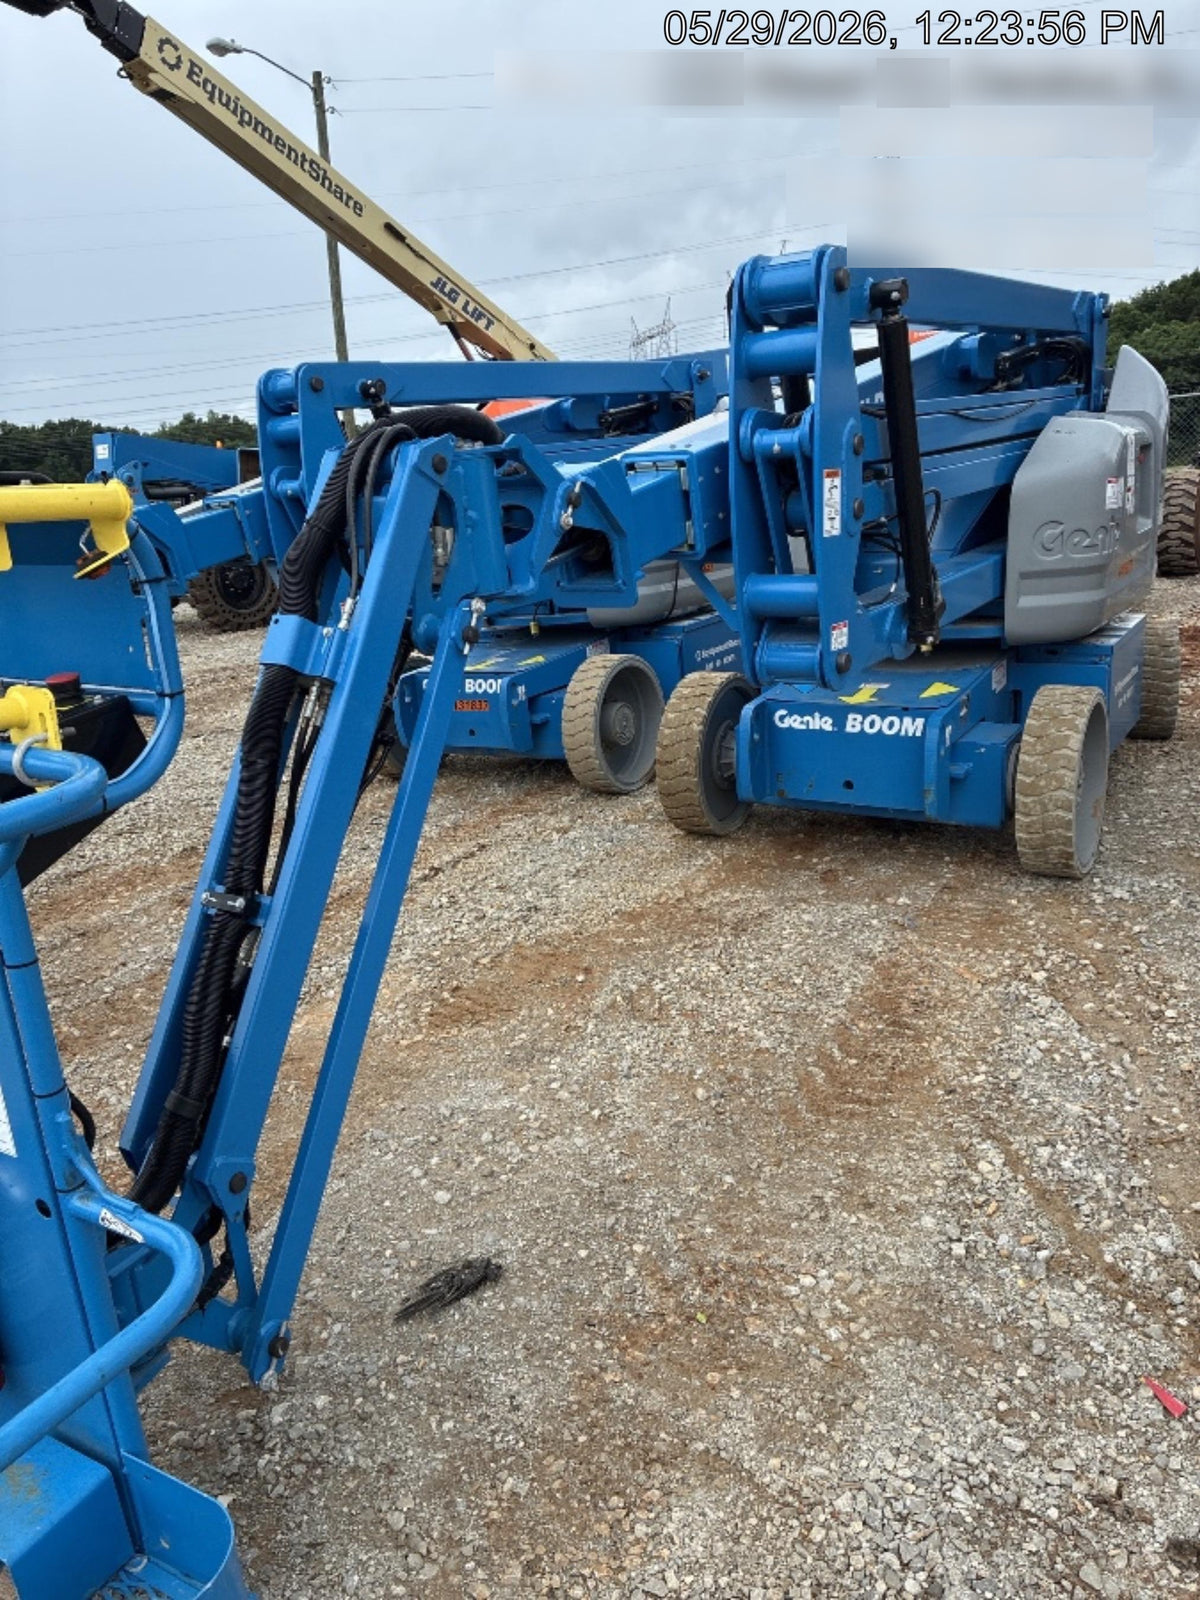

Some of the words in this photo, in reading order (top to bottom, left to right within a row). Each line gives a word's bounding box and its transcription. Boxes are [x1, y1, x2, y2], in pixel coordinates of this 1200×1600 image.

[186, 58, 364, 217] EquipmentShare
[430, 277, 461, 305] JLG
[462, 298, 495, 331] LIFT
[773, 708, 834, 732] Genie
[845, 713, 926, 737] BOOM
